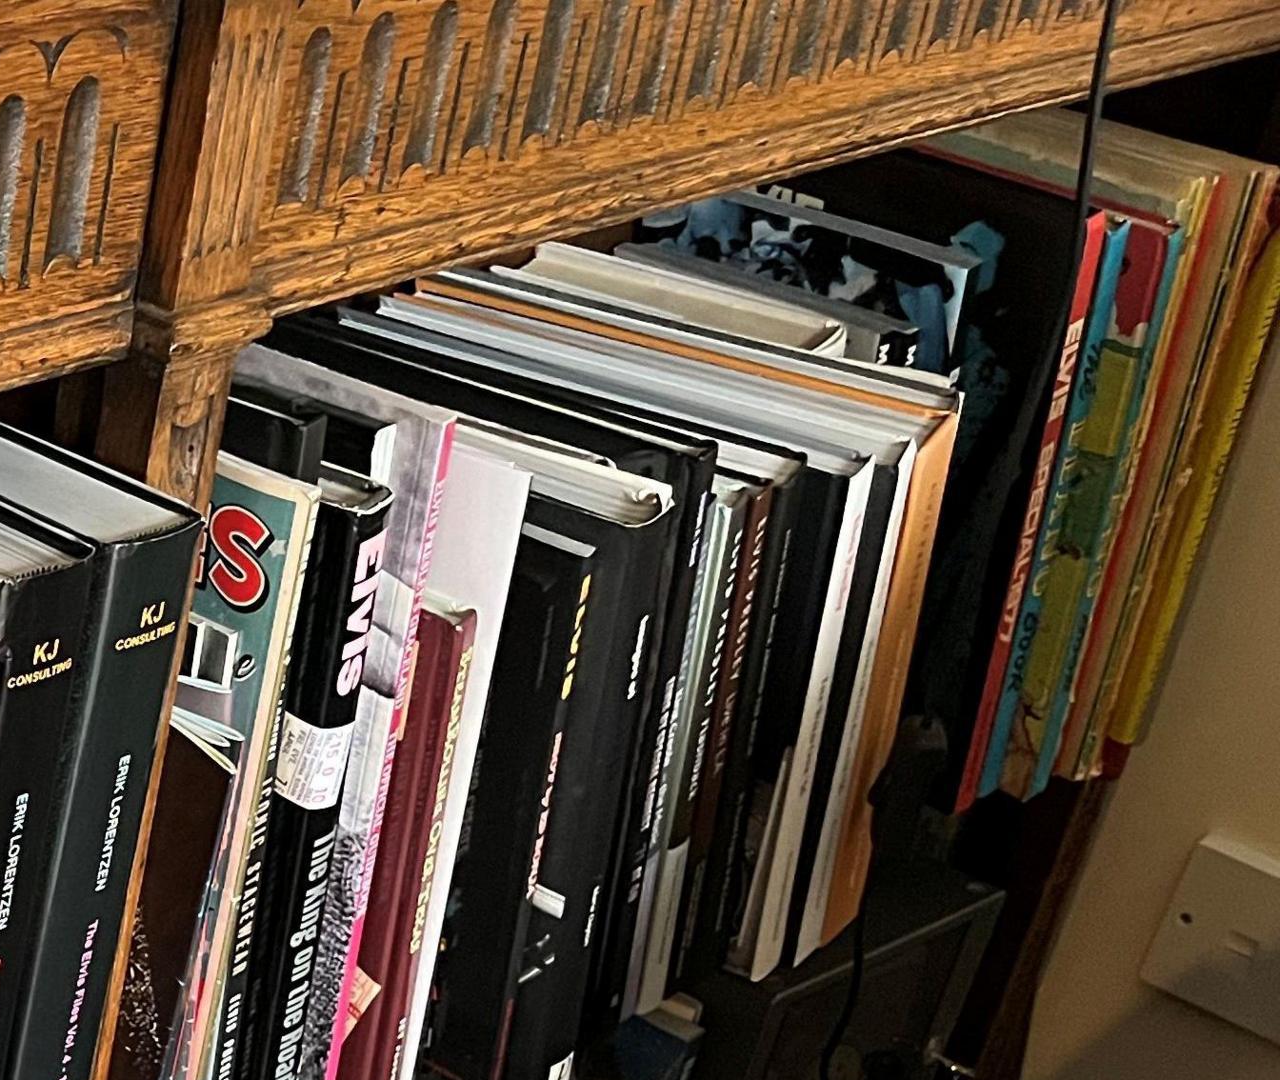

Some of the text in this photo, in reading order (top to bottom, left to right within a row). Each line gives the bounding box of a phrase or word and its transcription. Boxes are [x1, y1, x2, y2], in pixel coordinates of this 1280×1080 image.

[1047, 317, 1085, 424] ELVIS
[1013, 440, 1056, 579] SPECIAL
[115, 622, 176, 651] CONSULTING
[140, 601, 166, 628] KJ
[337, 528, 389, 697] ELVIS
[561, 574, 590, 700] ELVIS
[7, 658, 72, 689] CONSULTING
[33, 639, 59, 666] KJ
[14, 792, 30, 832] ERIK
[95, 753, 131, 892] ERIK LORENTZEN
[251, 777, 274, 853] ICONIC
[309, 830, 335, 877] The
[423, 820, 443, 885] OVER
[232, 862, 262, 976] STAGEWEAR
[290, 880, 328, 949] King
[409, 885, 431, 955] TEXAS
[292, 945, 312, 980] on
[225, 994, 241, 1033] ELVIS
[283, 978, 308, 1030] the
